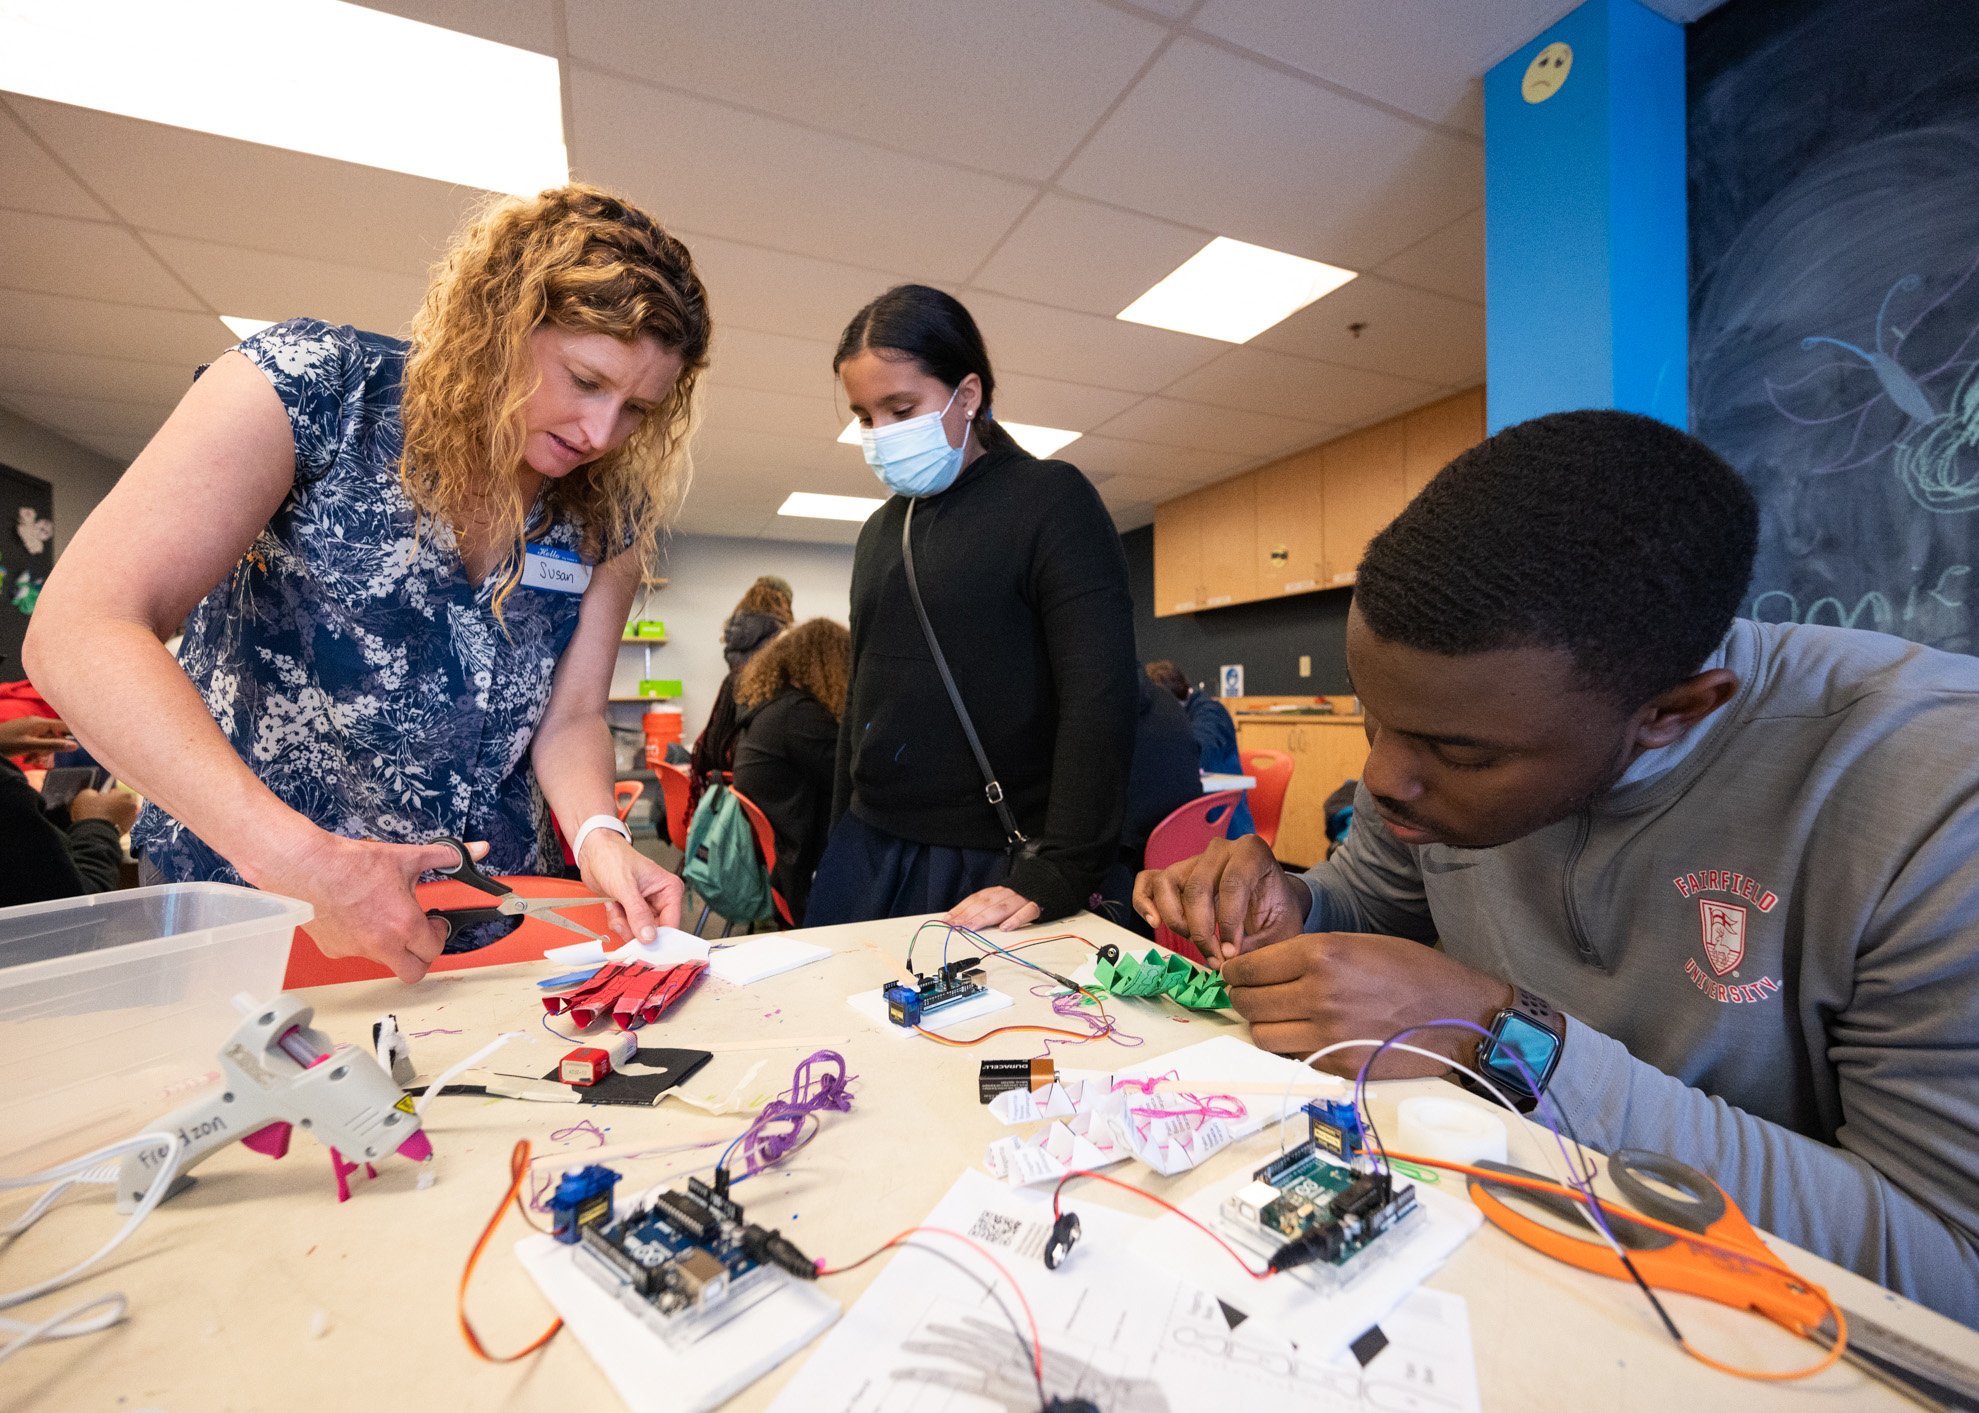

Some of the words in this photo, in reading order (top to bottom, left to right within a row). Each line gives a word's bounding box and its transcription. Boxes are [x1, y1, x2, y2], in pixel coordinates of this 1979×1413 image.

[537, 547, 561, 560] Hello
[540, 561, 574, 584] Susan
[1673, 870, 1778, 913] FAIRFIELD
[1684, 957, 1779, 1003] UNIVERSITY
